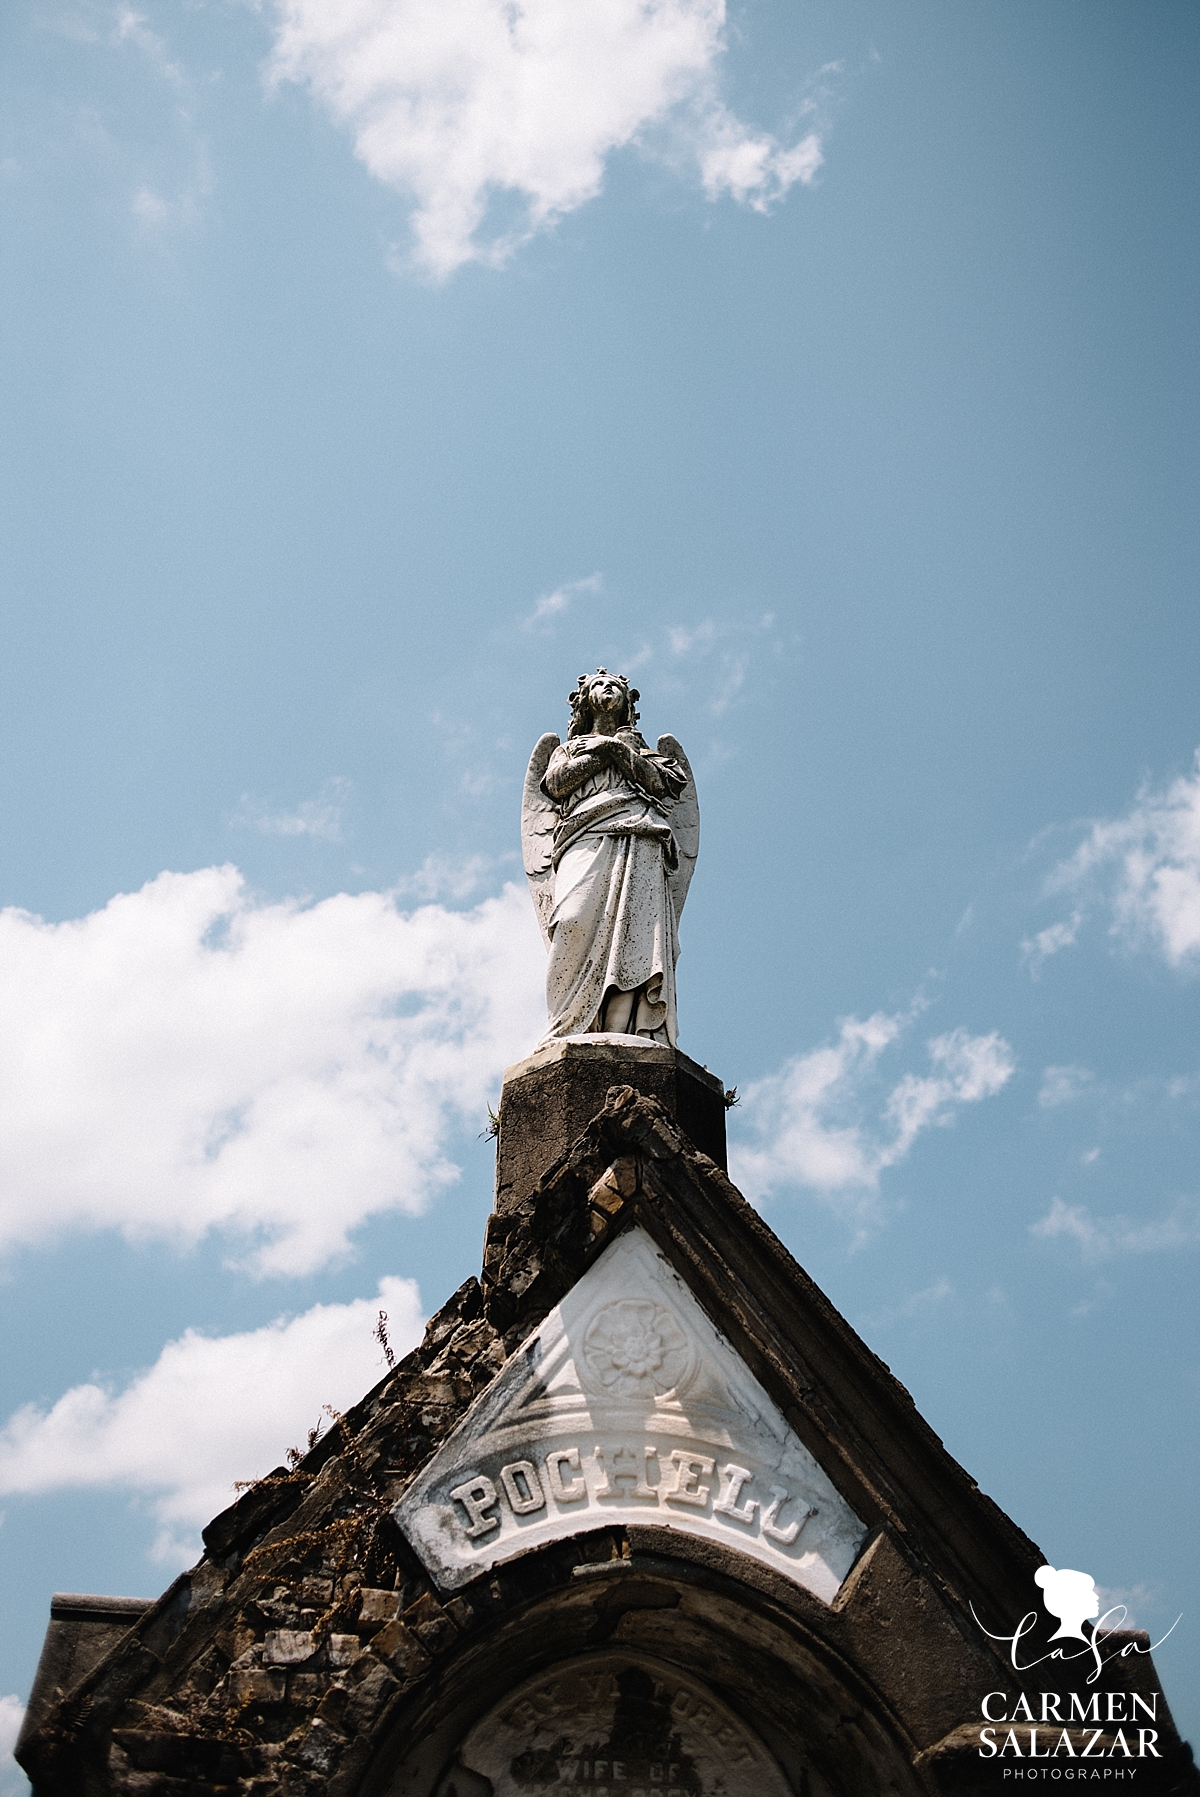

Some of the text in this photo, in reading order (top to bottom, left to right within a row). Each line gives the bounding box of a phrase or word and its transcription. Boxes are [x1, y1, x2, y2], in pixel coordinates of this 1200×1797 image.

[450, 1447, 817, 1546] POCHELU
[556, 1759, 681, 1782] WIFE OF
